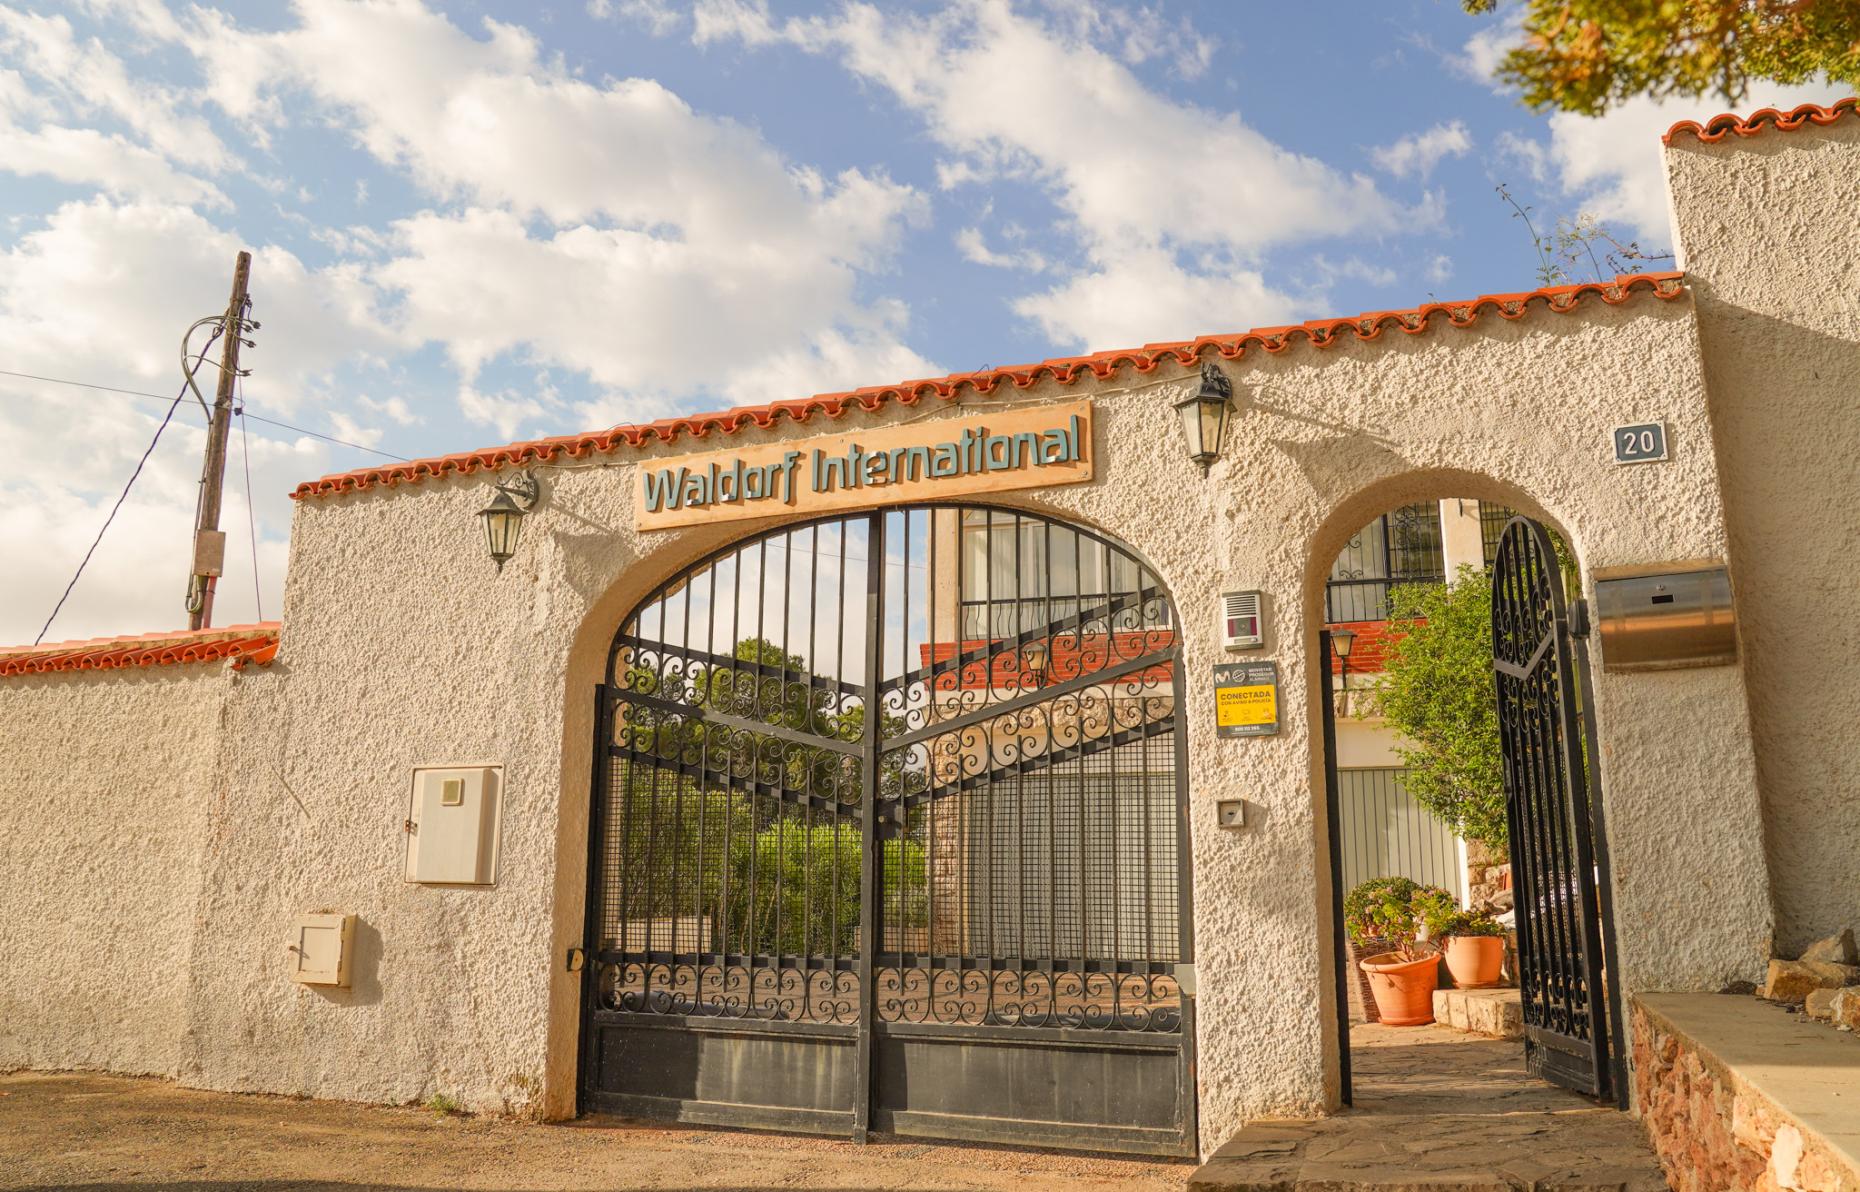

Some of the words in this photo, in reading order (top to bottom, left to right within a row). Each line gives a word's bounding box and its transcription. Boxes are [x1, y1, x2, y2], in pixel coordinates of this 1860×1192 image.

[1623, 430, 1655, 455] 20
[643, 450, 801, 512] Waldorf
[811, 414, 1079, 492] International
[1220, 691, 1271, 700] CONECTADA
